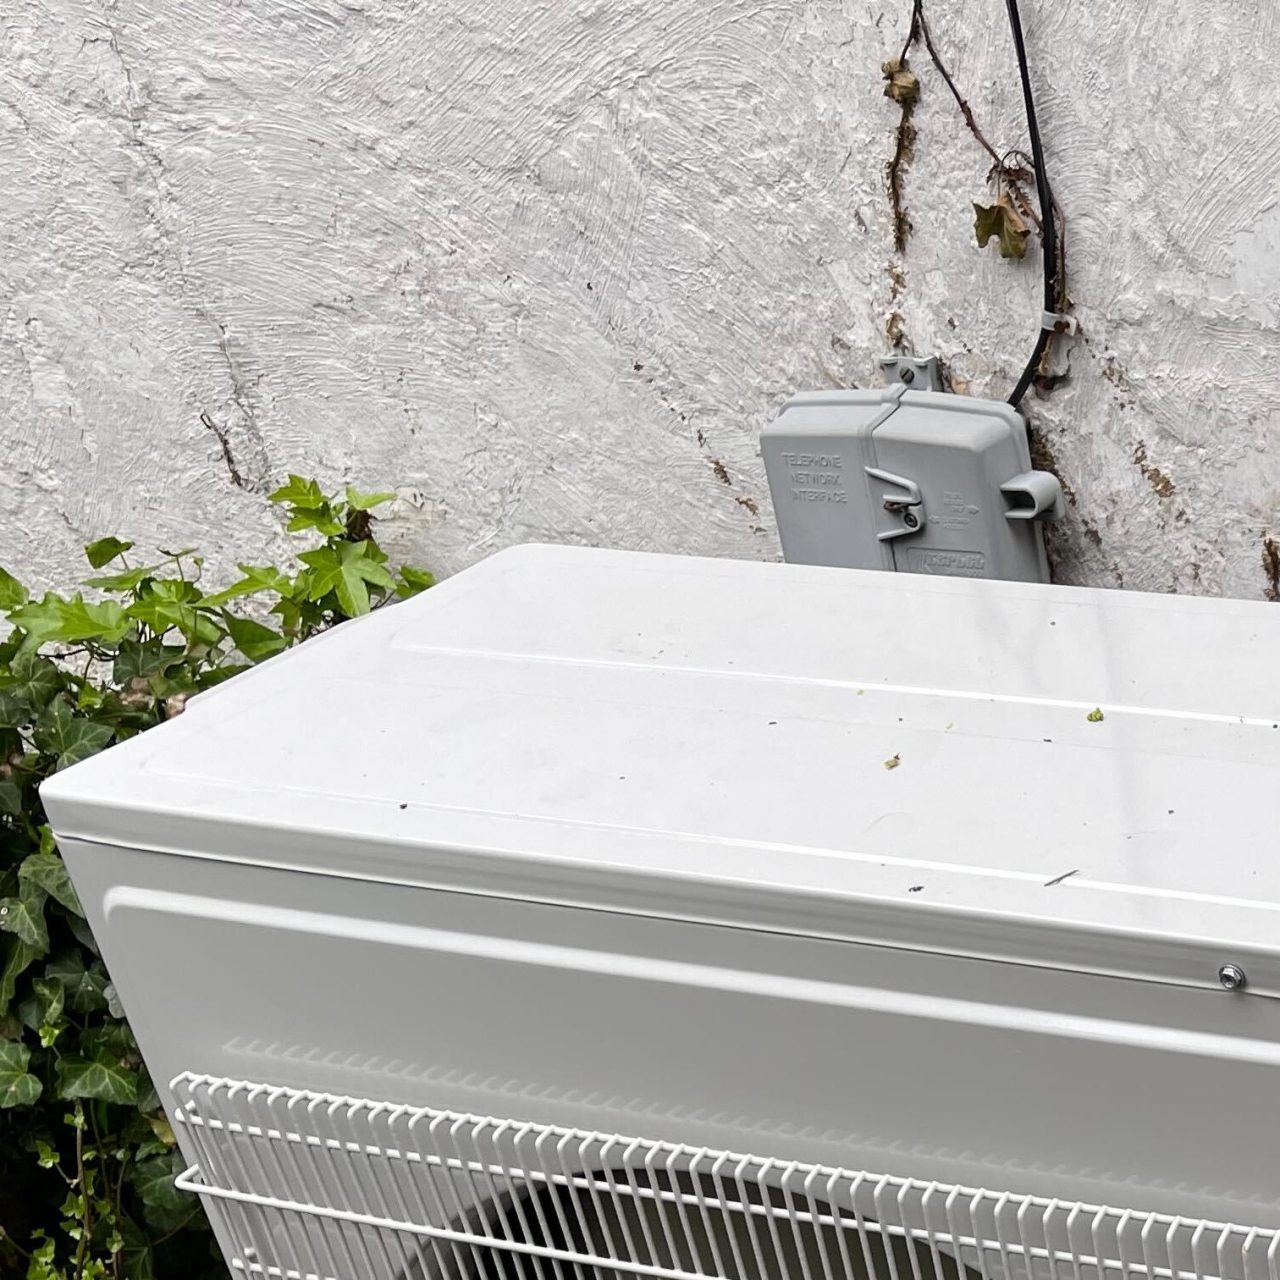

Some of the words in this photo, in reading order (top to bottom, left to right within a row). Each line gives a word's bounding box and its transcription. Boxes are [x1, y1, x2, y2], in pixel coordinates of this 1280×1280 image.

[781, 452, 842, 469] TELEPHONE
[790, 470, 841, 486] NETWORK
[790, 488, 847, 504] INTERFACE
